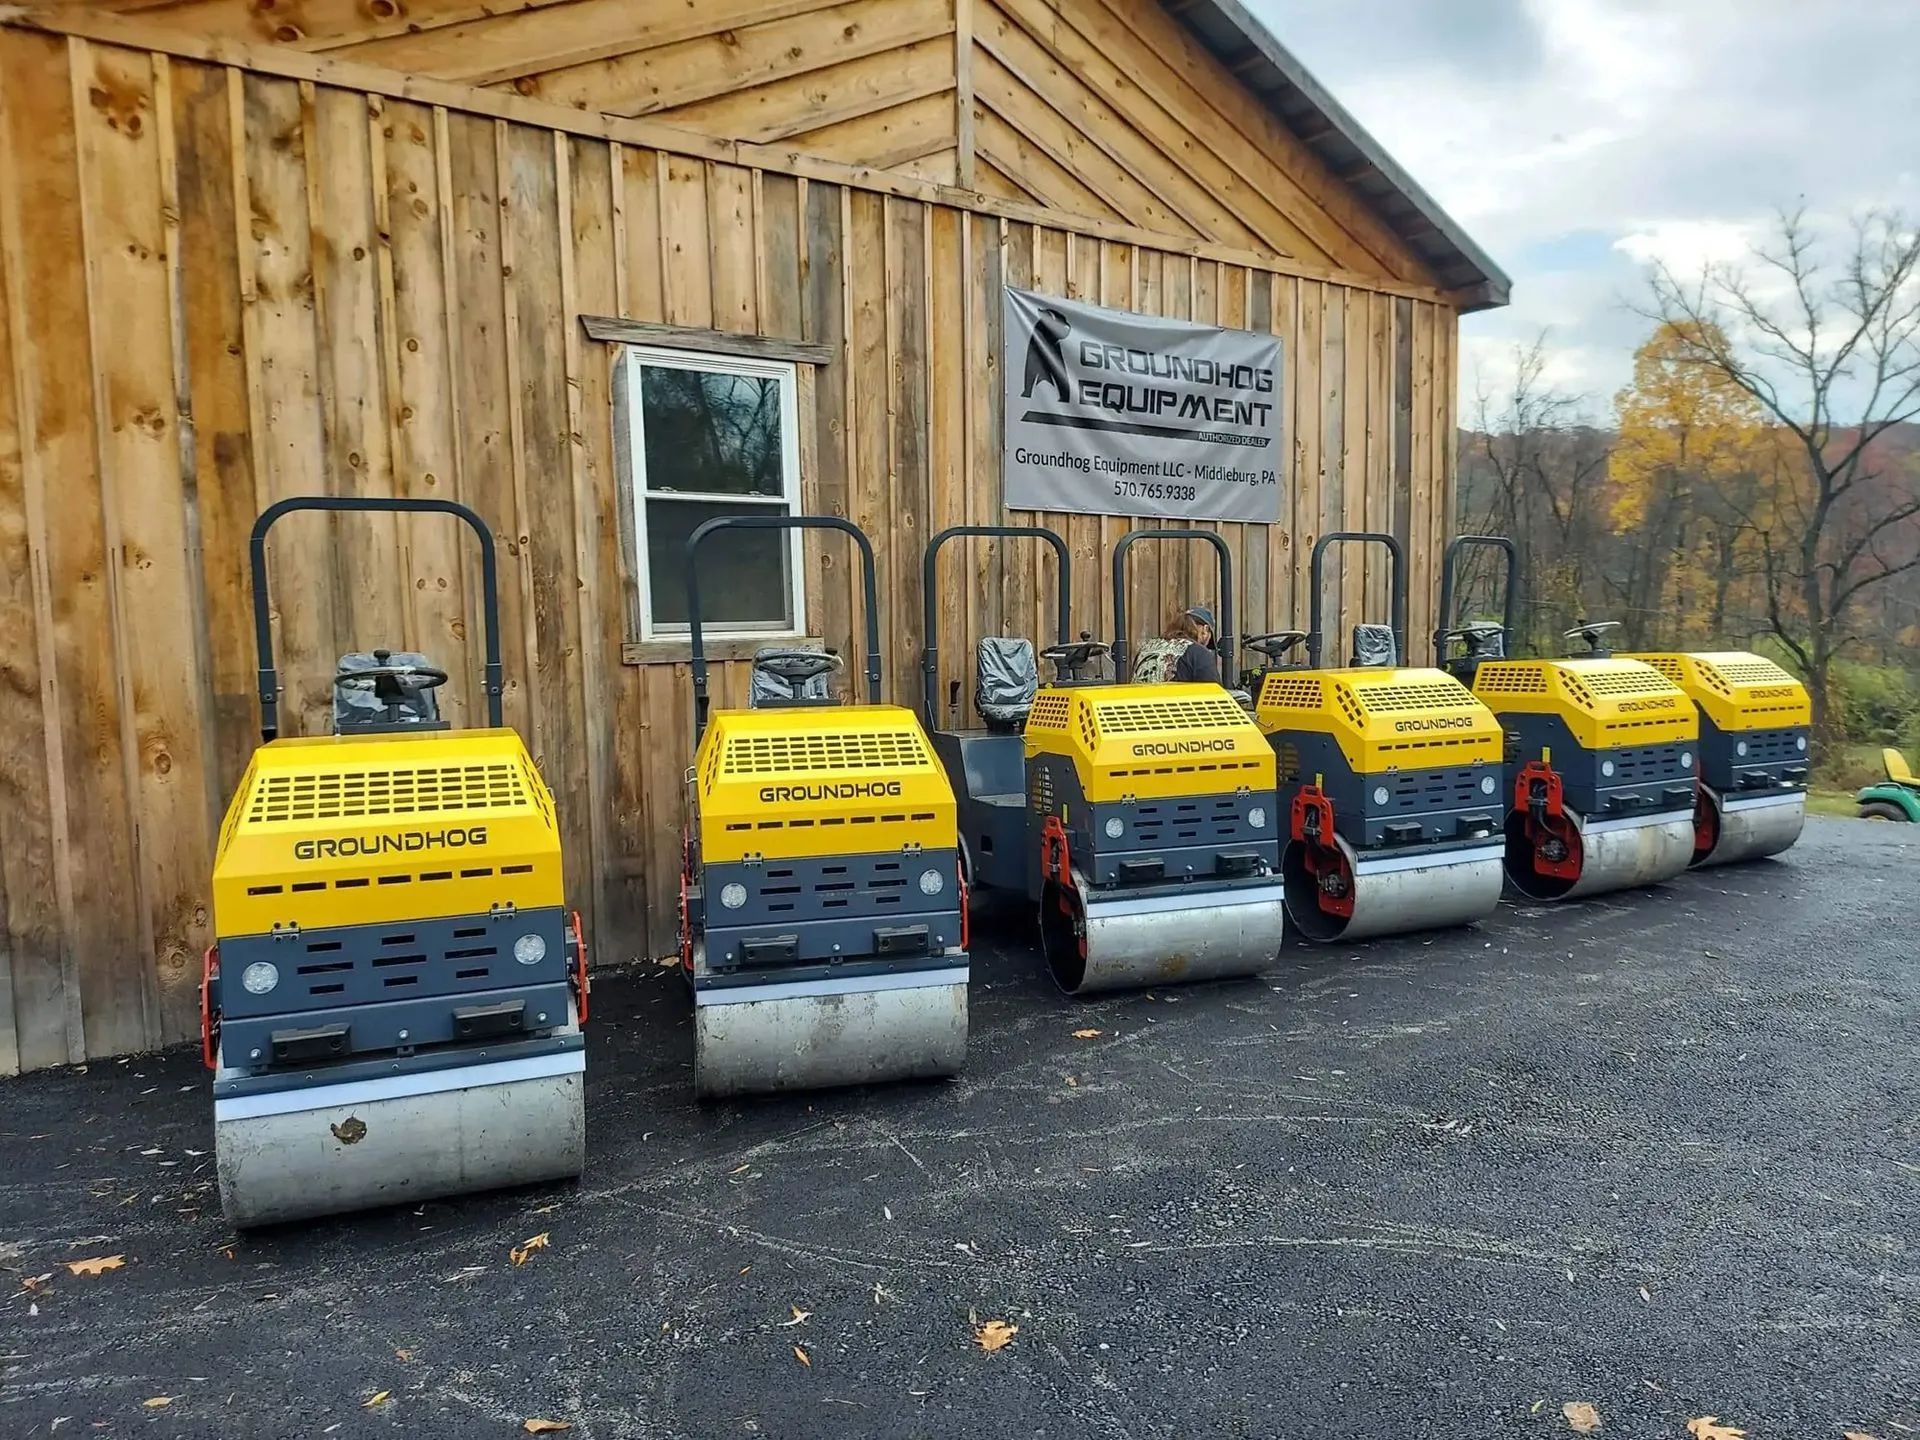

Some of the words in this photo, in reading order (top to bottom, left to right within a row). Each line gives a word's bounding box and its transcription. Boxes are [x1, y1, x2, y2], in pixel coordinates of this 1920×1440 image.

[1079, 340, 1273, 393] GROUNDHOG
[1078, 380, 1272, 427] EQUIPMENT
[1198, 431, 1241, 446] AUTHORIZED
[1241, 435, 1267, 448] DEALER
[1015, 447, 1090, 473] Groundhog
[1094, 457, 1160, 478] Equipment
[1163, 461, 1184, 478] LLC
[1195, 465, 1259, 486] Middleburg,
[1261, 470, 1276, 485] PA
[1114, 481, 1196, 501] 570.765.9338
[1749, 688, 1794, 699] GROUNDHOG
[1617, 699, 1676, 713] GROUNDHOG
[1395, 716, 1473, 732] GROUNDHOG
[1132, 739, 1235, 756] GROUNDHOG
[759, 781, 901, 803] GROUNDHOG
[294, 826, 488, 860] GROUNDHOG
